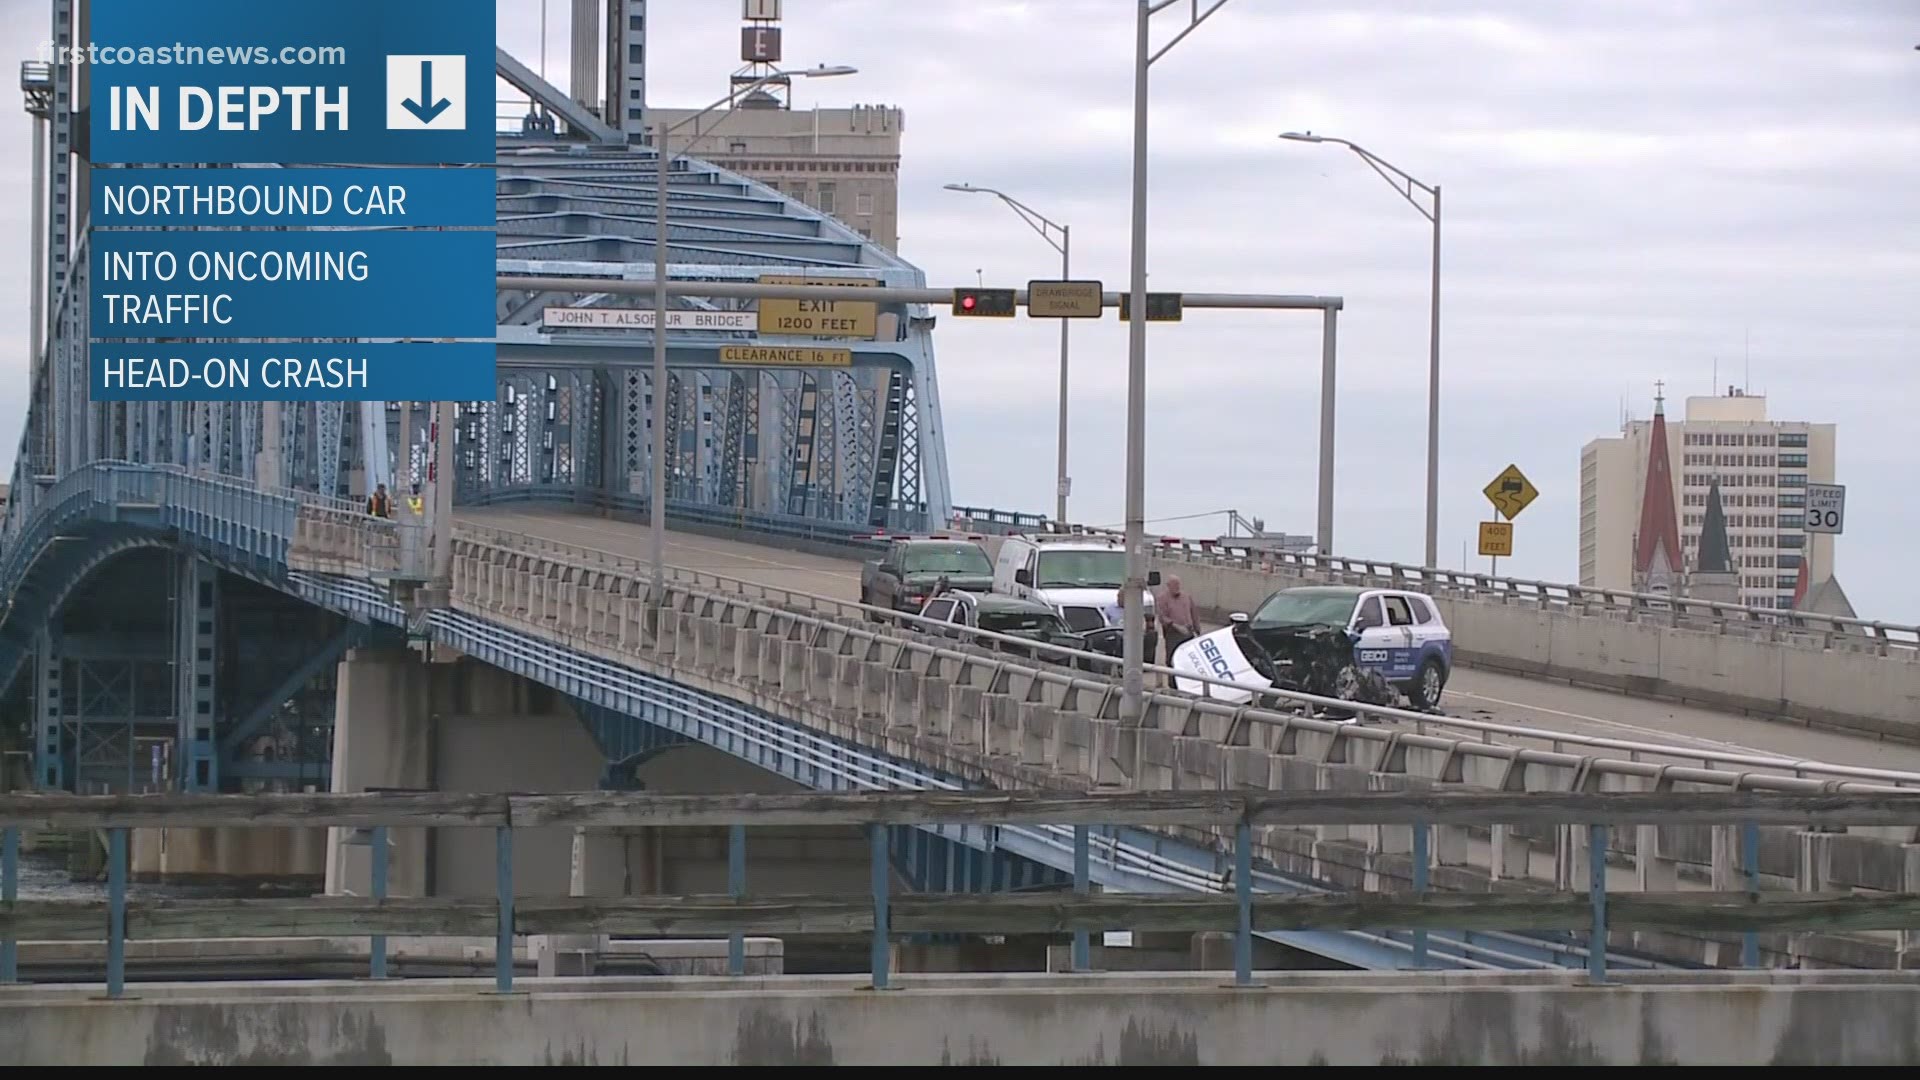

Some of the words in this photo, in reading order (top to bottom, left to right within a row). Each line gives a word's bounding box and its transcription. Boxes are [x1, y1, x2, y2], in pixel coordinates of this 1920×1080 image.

[799, 300, 835, 312] EXIT
[778, 317, 813, 329] 1200
[821, 319, 857, 330] FEET
[725, 349, 803, 361] CLEARANCE
[811, 351, 824, 362] 16
[832, 353, 844, 363] FT
[1809, 489, 1841, 498] SPEED
[1811, 499, 1838, 508] LIMIT
[1808, 509, 1839, 527] 30
[1487, 527, 1507, 536] 400
[1484, 542, 1505, 551] FEET
